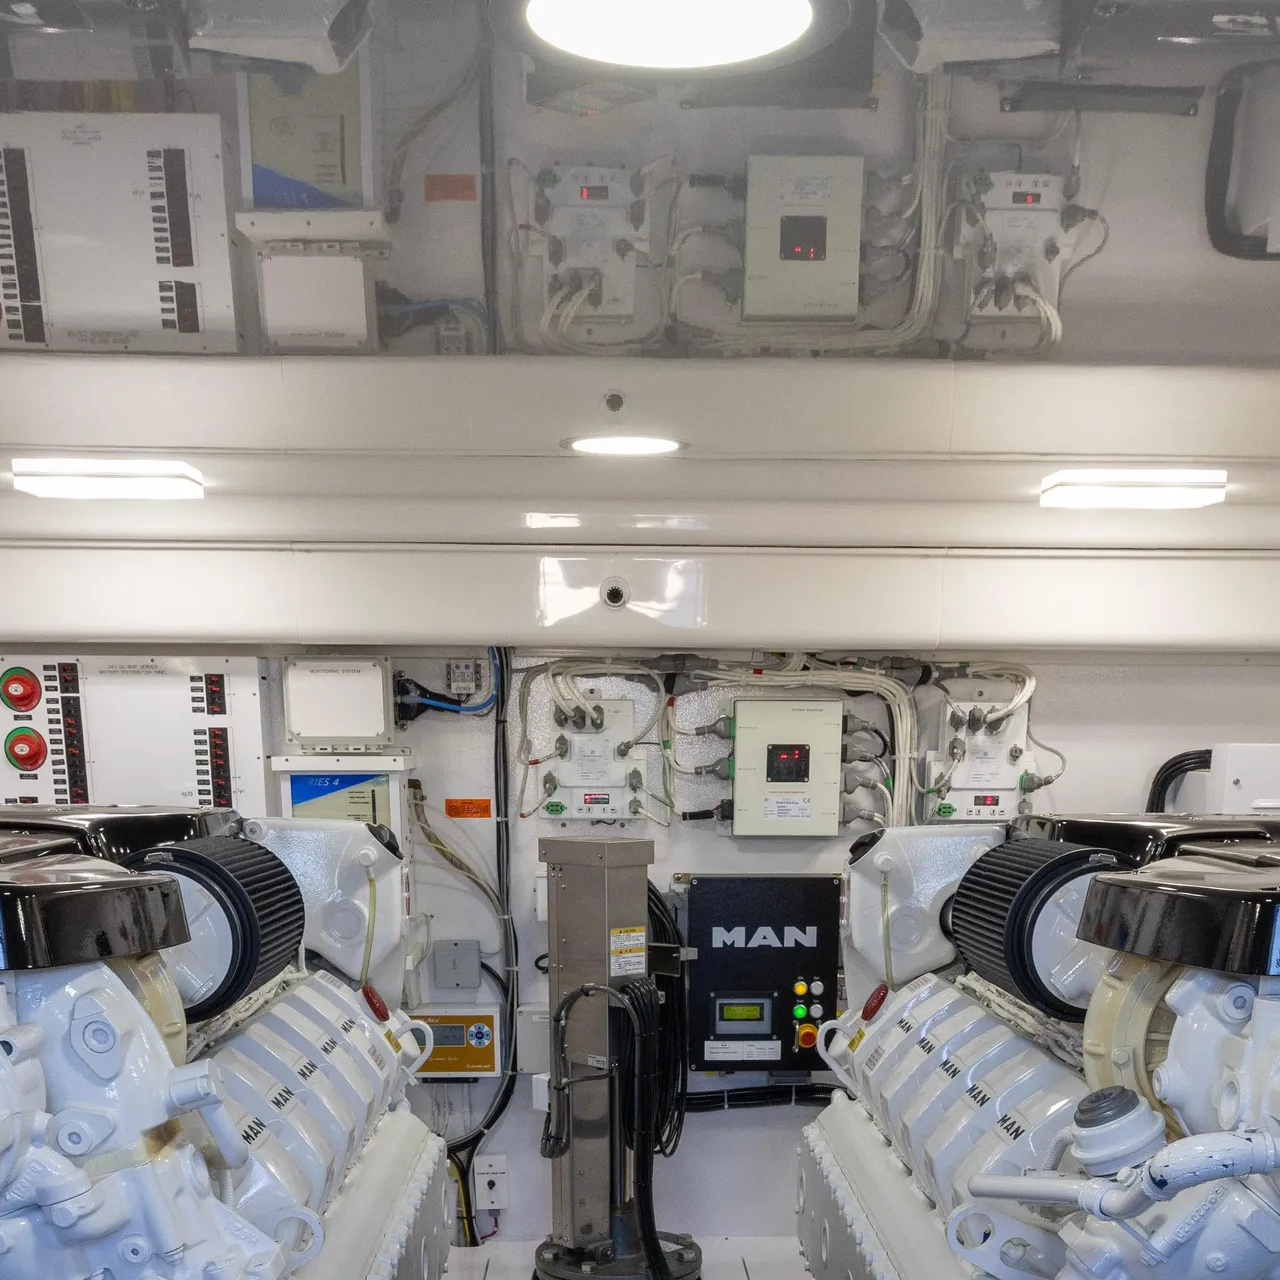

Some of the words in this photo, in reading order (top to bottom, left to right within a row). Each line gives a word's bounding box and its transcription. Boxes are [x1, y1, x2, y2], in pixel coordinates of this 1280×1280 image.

[332, 777, 340, 787] 4
[712, 926, 817, 947] MAN
[340, 1018, 356, 1034] MAN
[897, 1018, 913, 1034] MAN
[320, 1038, 339, 1055] MAN
[916, 1036, 935, 1055] MAN
[297, 1060, 318, 1081] MAN
[939, 1059, 961, 1079] MAN
[271, 1086, 295, 1110] MAN
[966, 1084, 991, 1107] MAN
[241, 1117, 267, 1145] MAN
[997, 1114, 1026, 1141] MAN
